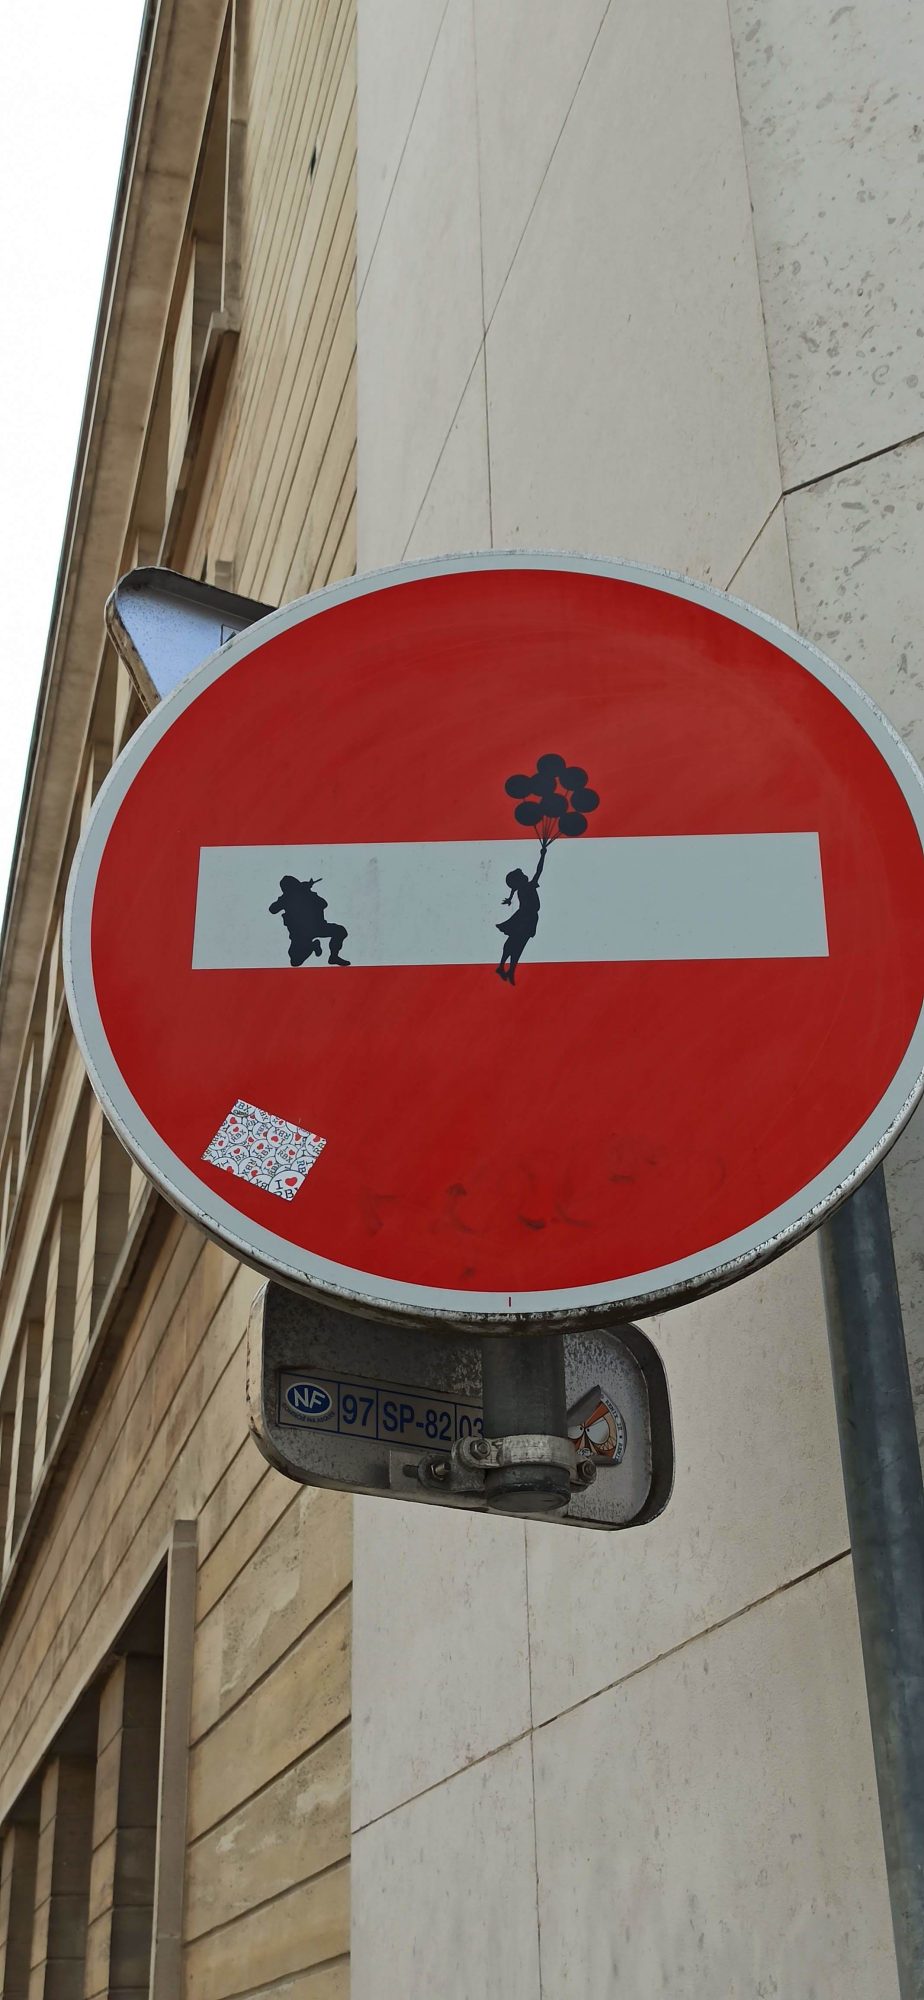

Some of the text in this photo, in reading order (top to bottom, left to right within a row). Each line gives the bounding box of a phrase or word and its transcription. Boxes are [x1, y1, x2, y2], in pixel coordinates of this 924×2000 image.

[231, 1129, 247, 1142] RBX
[272, 1127, 291, 1140] RBX
[277, 1150, 293, 1163] RBX
[275, 1179, 283, 1190] I
[293, 1387, 325, 1409] NF
[342, 1394, 374, 1427] 97
[382, 1401, 451, 1441] SP-82
